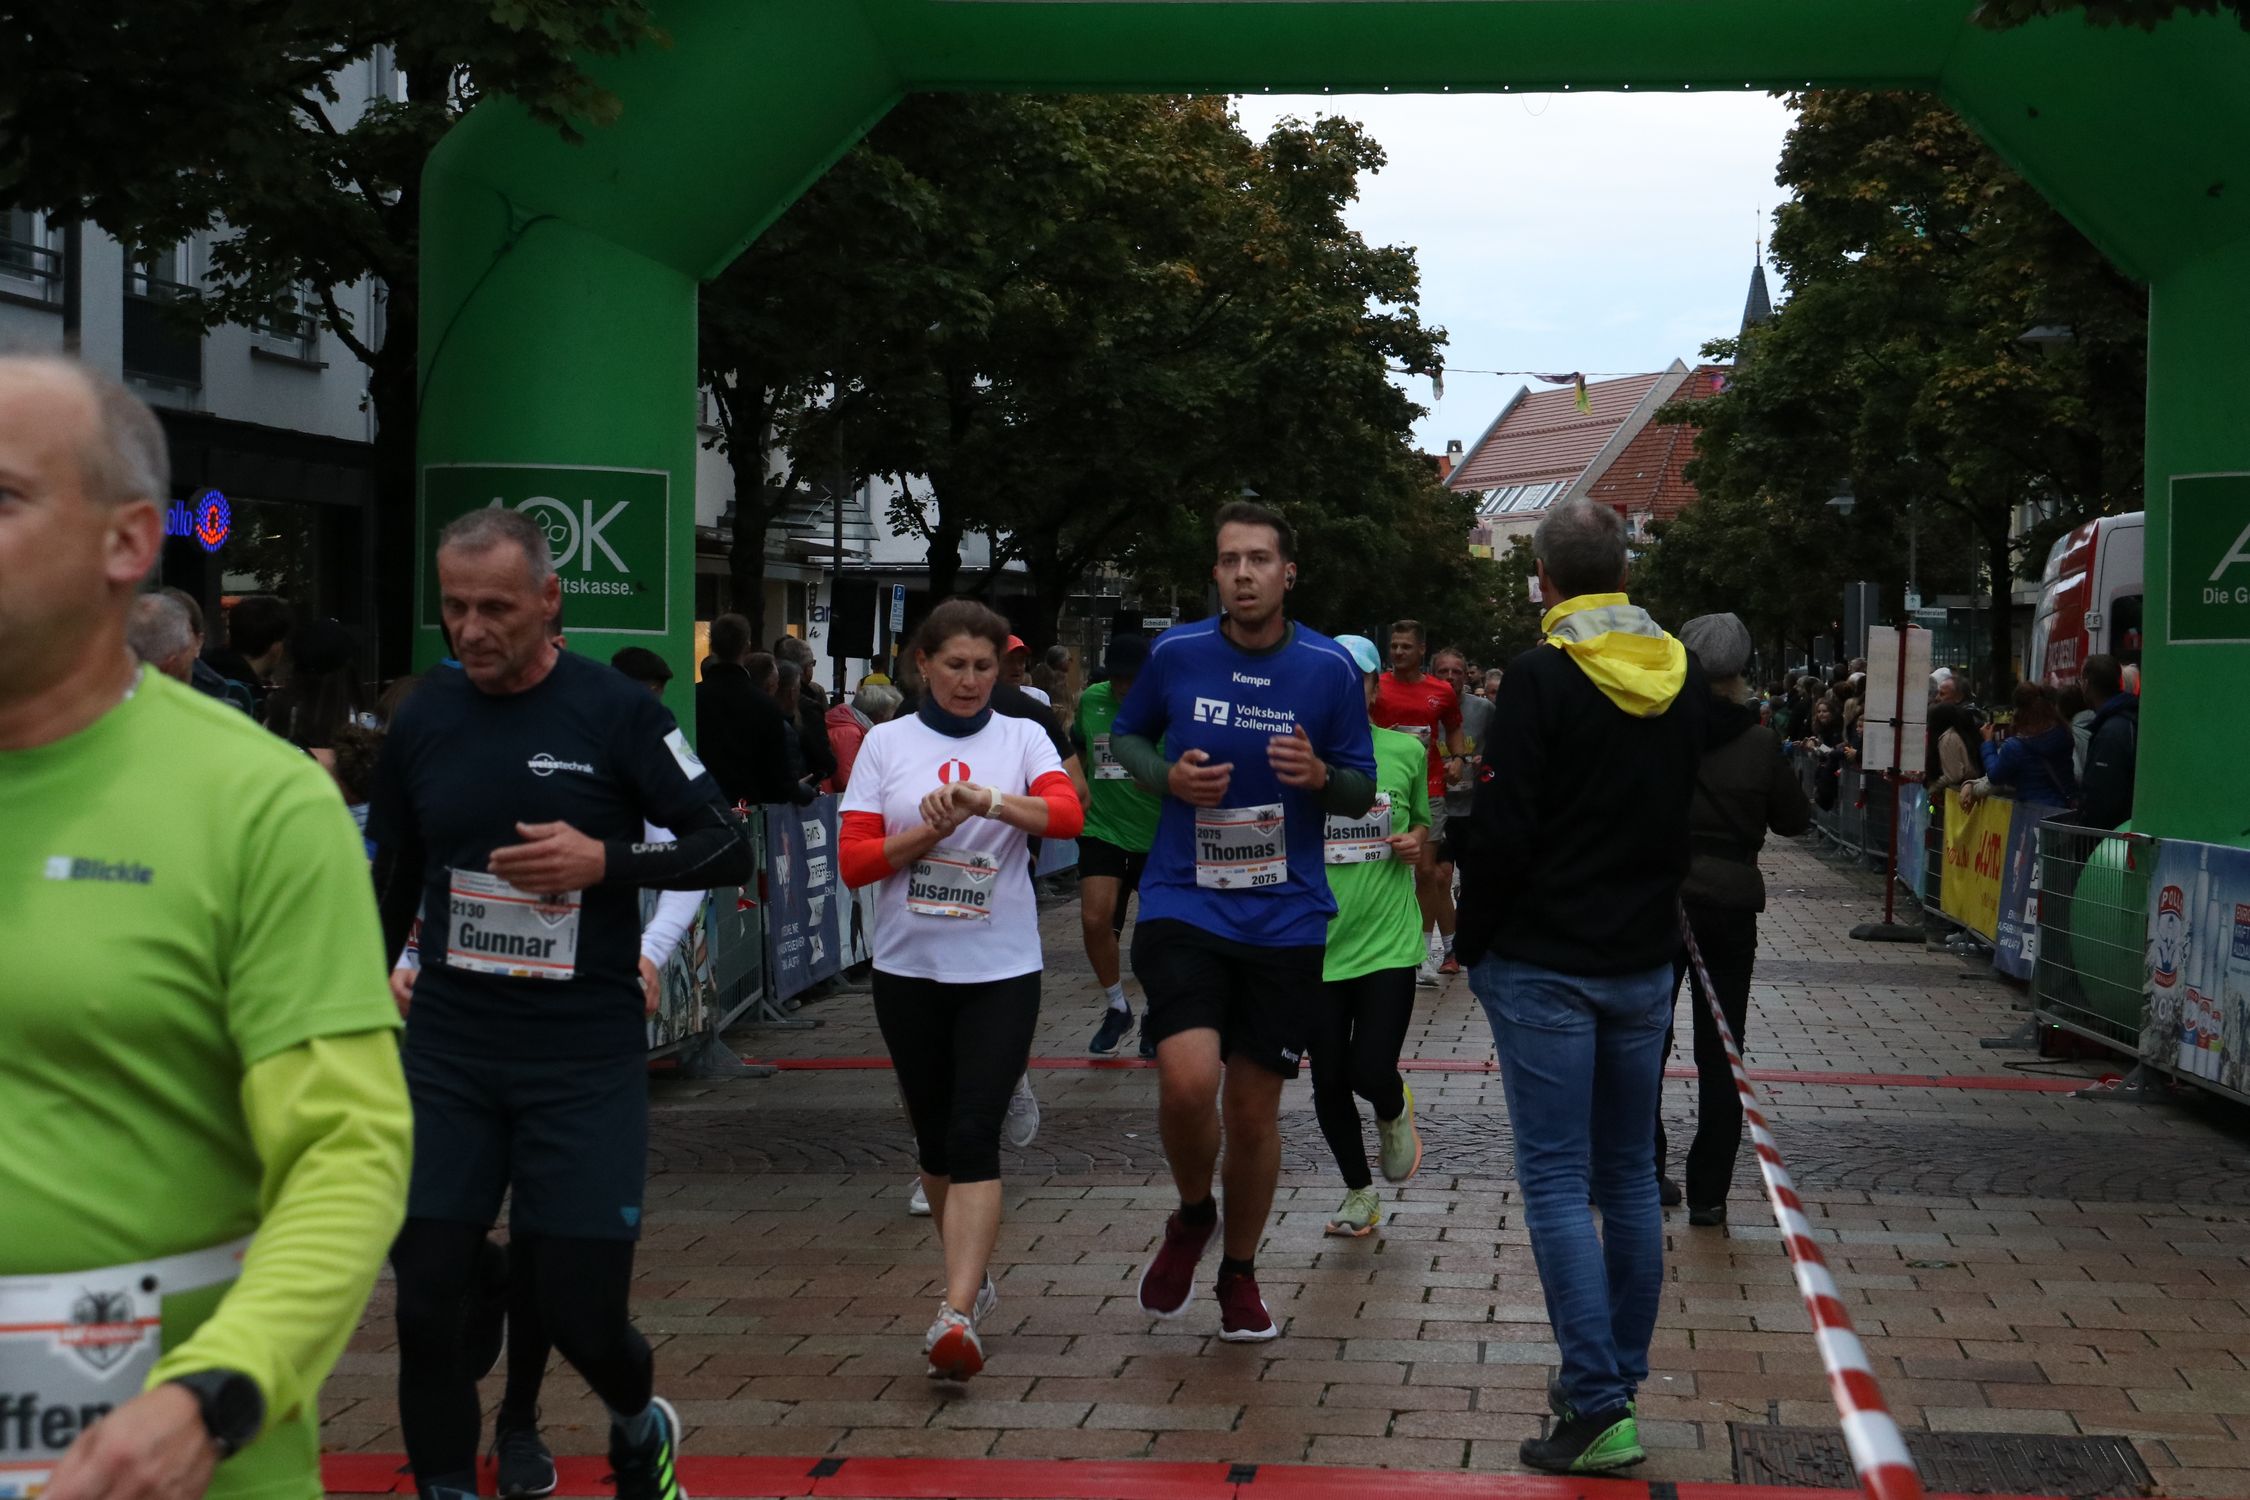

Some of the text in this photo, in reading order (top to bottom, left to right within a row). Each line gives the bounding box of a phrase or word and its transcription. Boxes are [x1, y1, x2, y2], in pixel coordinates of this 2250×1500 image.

[488, 495, 631, 574] OK
[2203, 587, 2250, 605] Die G
[1232, 671, 1271, 688] Kempa
[1236, 704, 1295, 721] Volksbank
[1234, 717, 1293, 734] Zollernalb
[1197, 828, 1222, 840] 2075
[1324, 823, 1381, 840] Jasmin
[1202, 842, 1276, 861] Thomas
[1365, 851, 1381, 861] 897
[1251, 872, 1278, 885] 2075
[908, 878, 985, 906] Susanne
[451, 900, 486, 919] 2130
[459, 922, 557, 959] Gunnar
